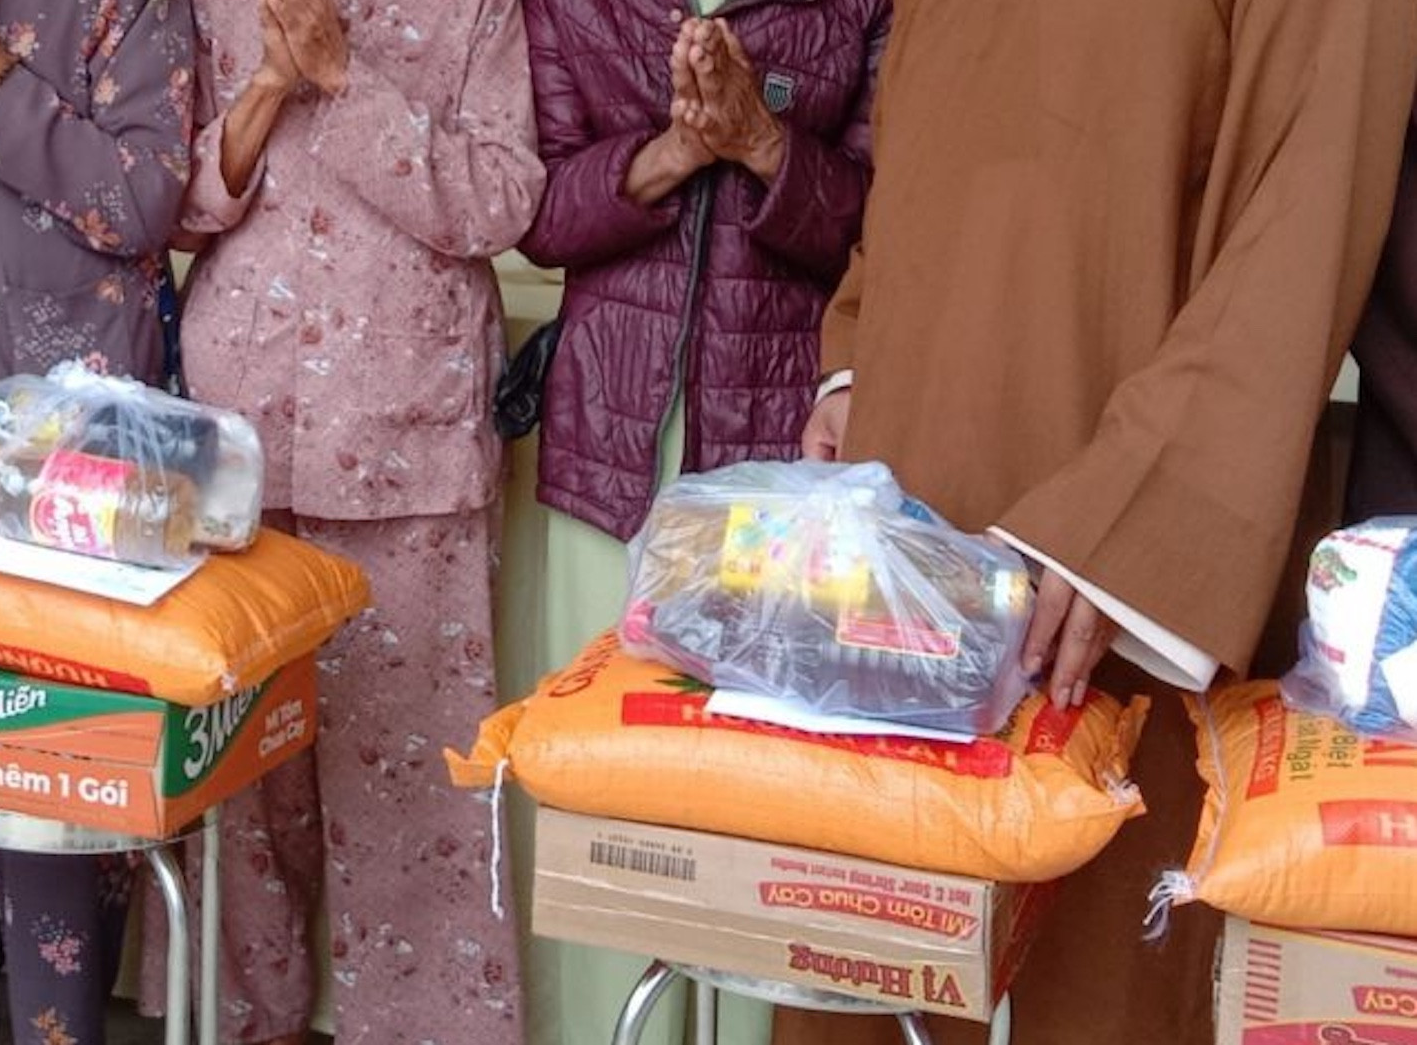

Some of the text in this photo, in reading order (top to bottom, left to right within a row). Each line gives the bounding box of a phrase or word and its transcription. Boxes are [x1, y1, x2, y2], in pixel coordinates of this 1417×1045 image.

[57, 773, 71, 798] 1
[77, 776, 130, 808] Gói
[768, 883, 815, 905] Cay
[819, 890, 882, 915] Chua
